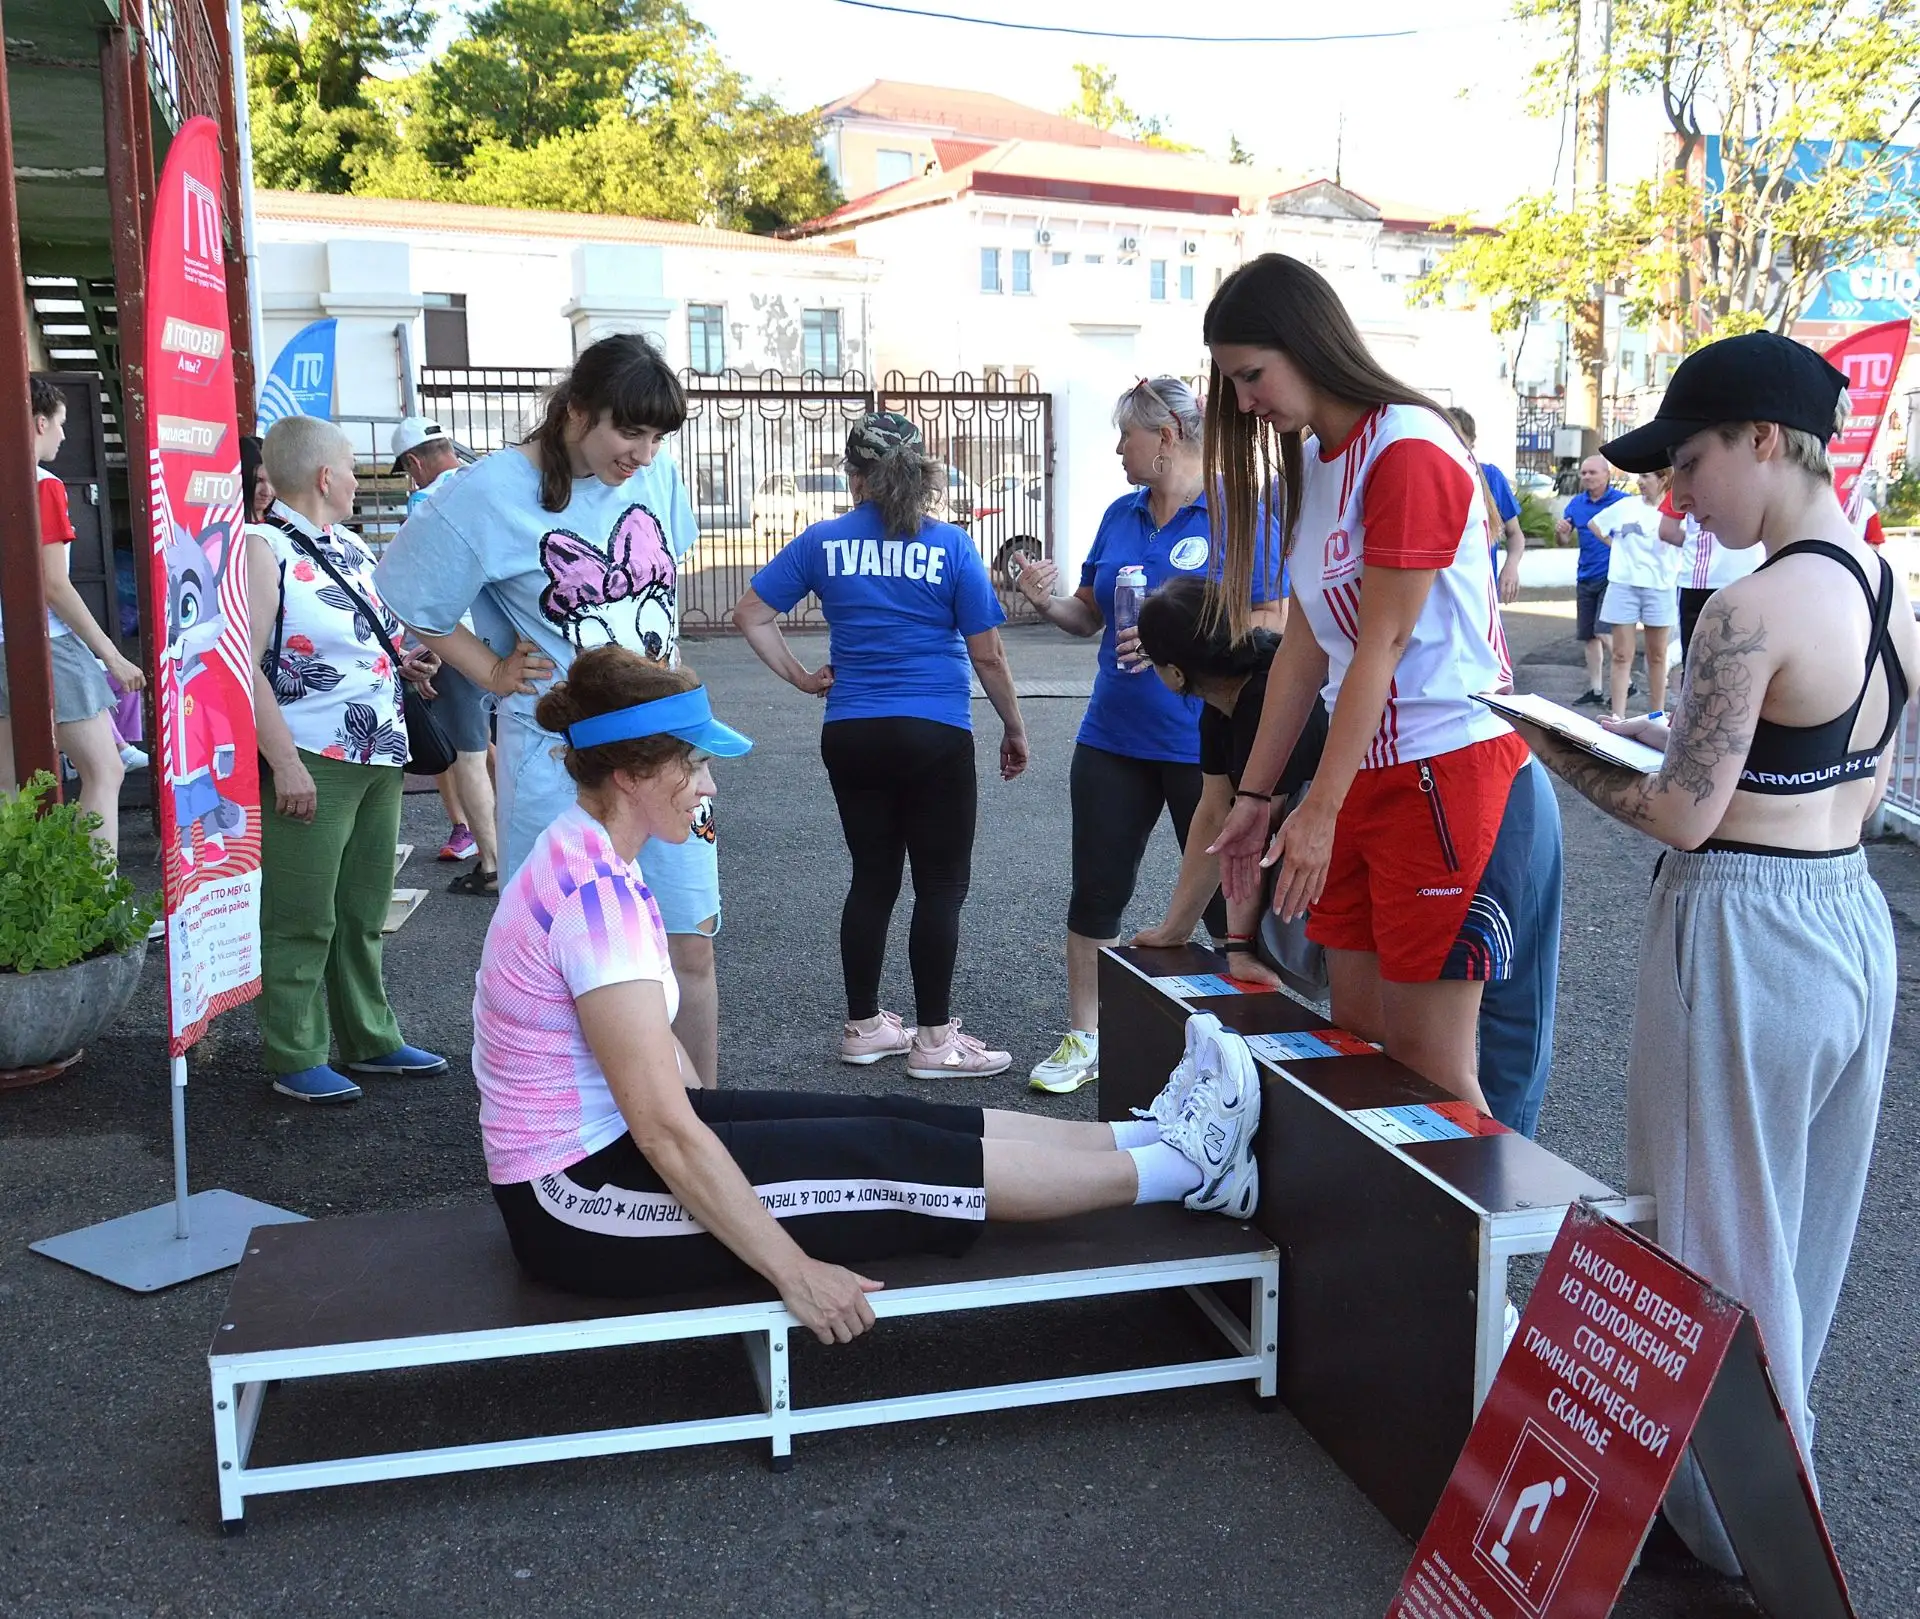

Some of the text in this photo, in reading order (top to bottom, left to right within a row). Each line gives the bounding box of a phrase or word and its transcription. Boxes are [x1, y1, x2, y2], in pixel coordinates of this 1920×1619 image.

[174, 324, 218, 356] ГОТОВ!
[177, 353, 185, 371] А
[193, 476, 233, 500] #ГТО
[822, 539, 946, 585] ТУАПСЕ
[1741, 764, 1841, 785] ARMOUR
[210, 887, 226, 901] ГТО
[1416, 887, 1463, 897] FORWARD
[565, 1193, 577, 1209] &
[759, 1192, 796, 1210] TREND
[800, 1190, 810, 1204] &
[811, 1189, 841, 1203] COOL
[857, 1188, 904, 1203] TRENDY
[908, 1192, 917, 1205] &
[920, 1193, 949, 1208] COOL
[579, 1196, 612, 1216] COOL
[627, 1203, 683, 1222] TRENDY
[1568, 1241, 1704, 1354] НАКЛОН ВПЕРЕД
[1558, 1273, 1688, 1383] ИЗ ПОЛОЖЕНИЯ
[1573, 1325, 1640, 1392] СТОЯ НА
[1523, 1326, 1670, 1459] ГИМНАСТИЧЕСКОЙ
[1546, 1387, 1613, 1455] СКАМЬЕ
[1421, 1559, 1441, 1584] ногами
[1432, 1549, 1452, 1576] Наклон
[1451, 1573, 1471, 1599] вперед
[1416, 1572, 1441, 1604] исходного
